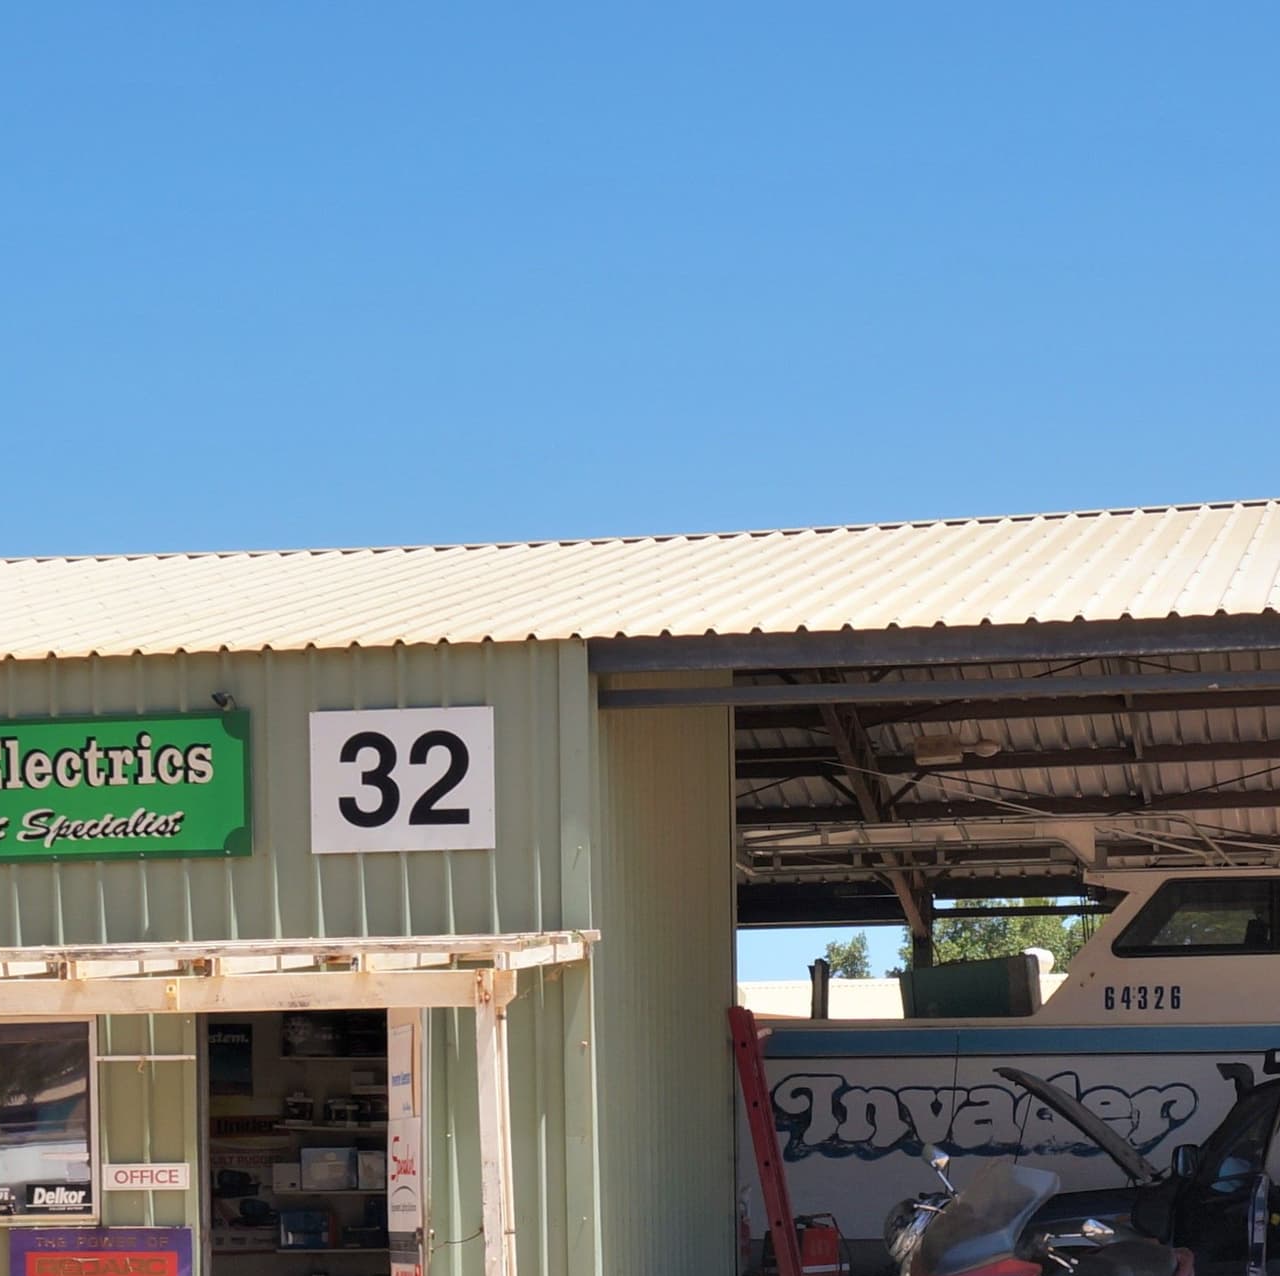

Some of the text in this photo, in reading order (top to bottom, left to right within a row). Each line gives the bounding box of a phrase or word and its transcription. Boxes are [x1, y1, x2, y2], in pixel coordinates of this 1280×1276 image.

[338, 730, 470, 828] 32
[16, 807, 186, 848] Specialist
[1104, 985, 1181, 1010] 64326
[114, 1169, 180, 1185] OFFICE
[34, 1186, 86, 1204] Delkor
[36, 1256, 168, 1276] REDARC
